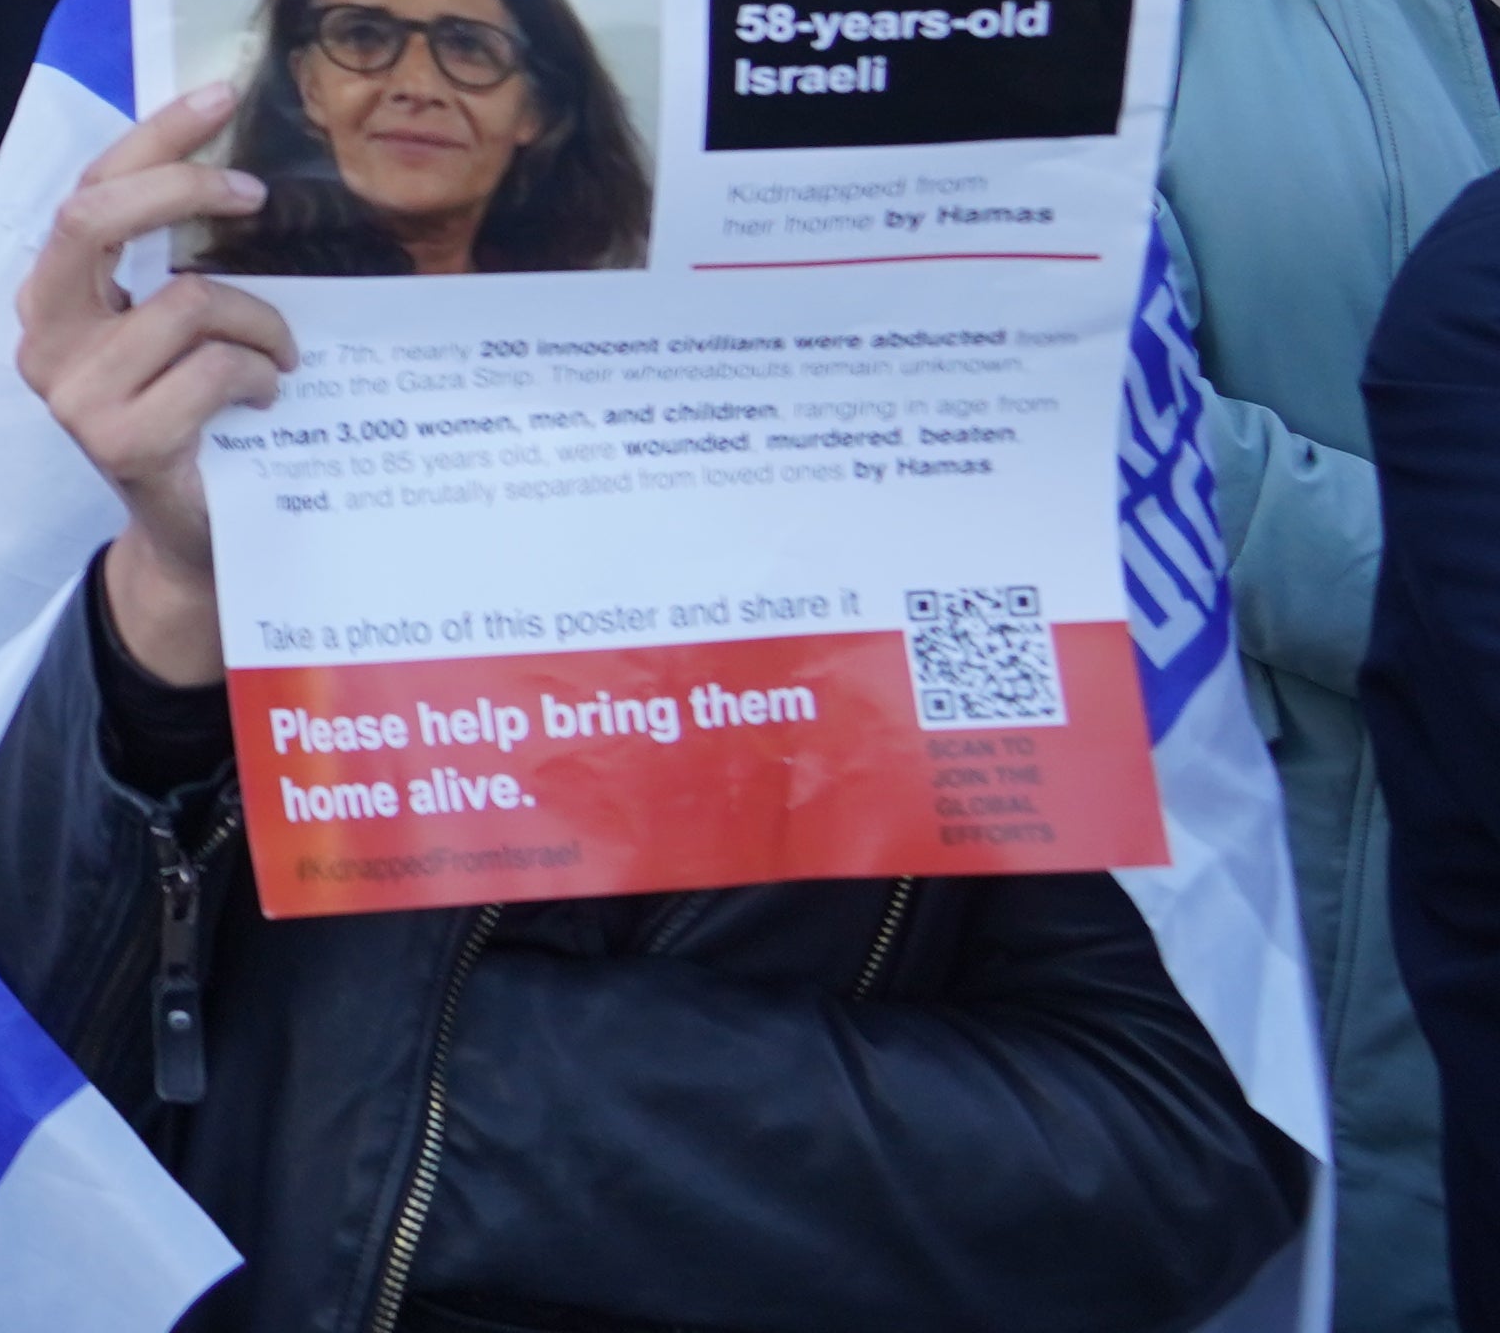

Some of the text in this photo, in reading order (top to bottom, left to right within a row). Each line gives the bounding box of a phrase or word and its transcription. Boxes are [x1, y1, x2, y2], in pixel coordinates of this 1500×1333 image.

[736, 0, 1049, 49] 58-years-old
[735, 56, 886, 95] Israeli
[271, 683, 816, 753] Please help bring them
[281, 769, 534, 821] home alive.
